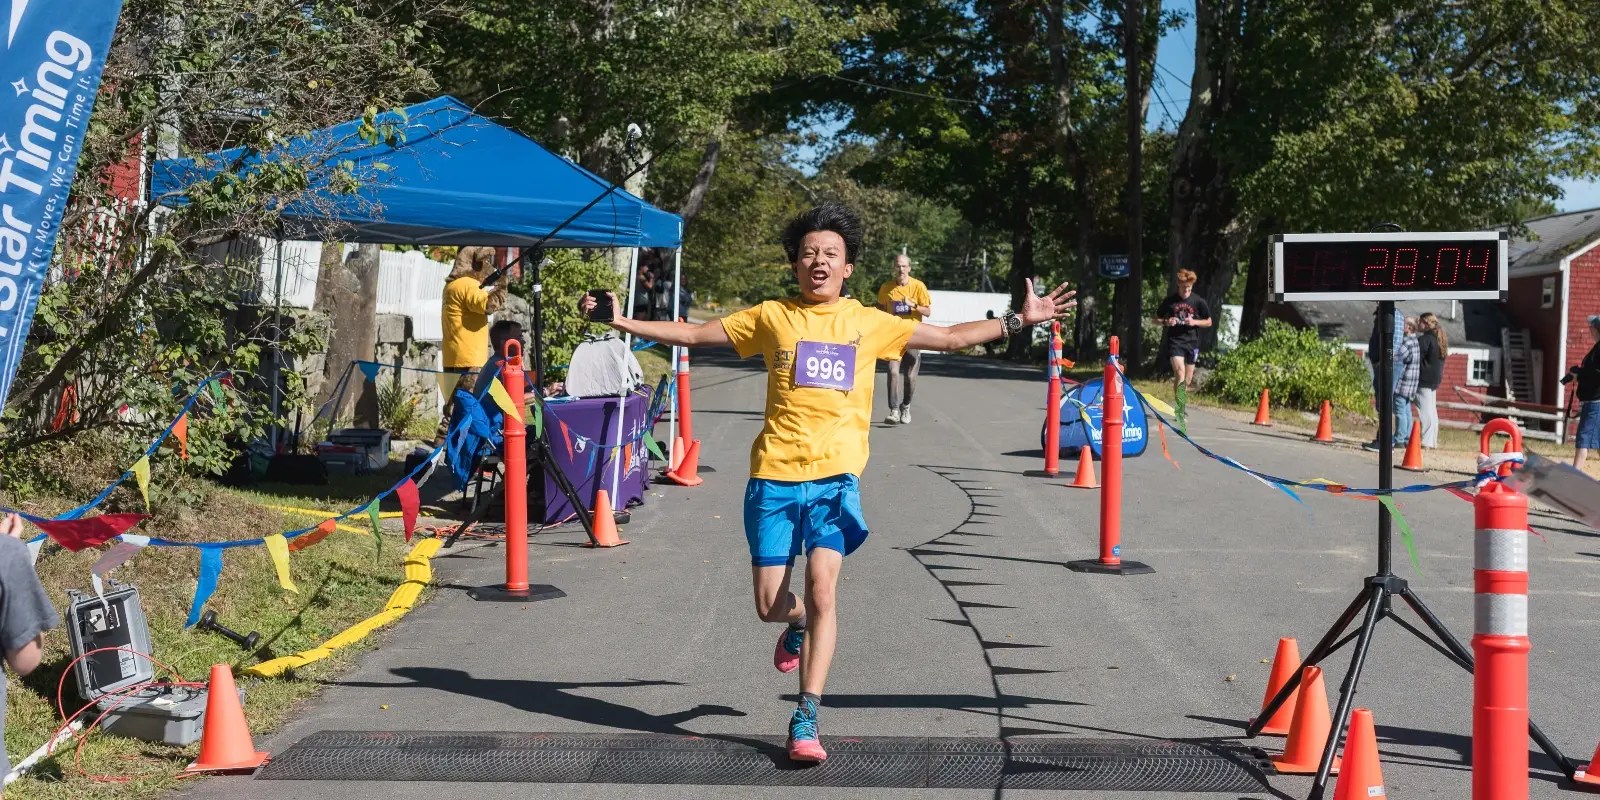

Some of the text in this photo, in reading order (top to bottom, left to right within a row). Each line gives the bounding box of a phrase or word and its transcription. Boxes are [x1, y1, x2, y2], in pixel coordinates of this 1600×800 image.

[0, 30, 92, 195] Timing
[27, 75, 92, 273] If It Moves, We Can Time It.
[1362, 248, 1491, 286] 28:04
[806, 356, 846, 381] 996
